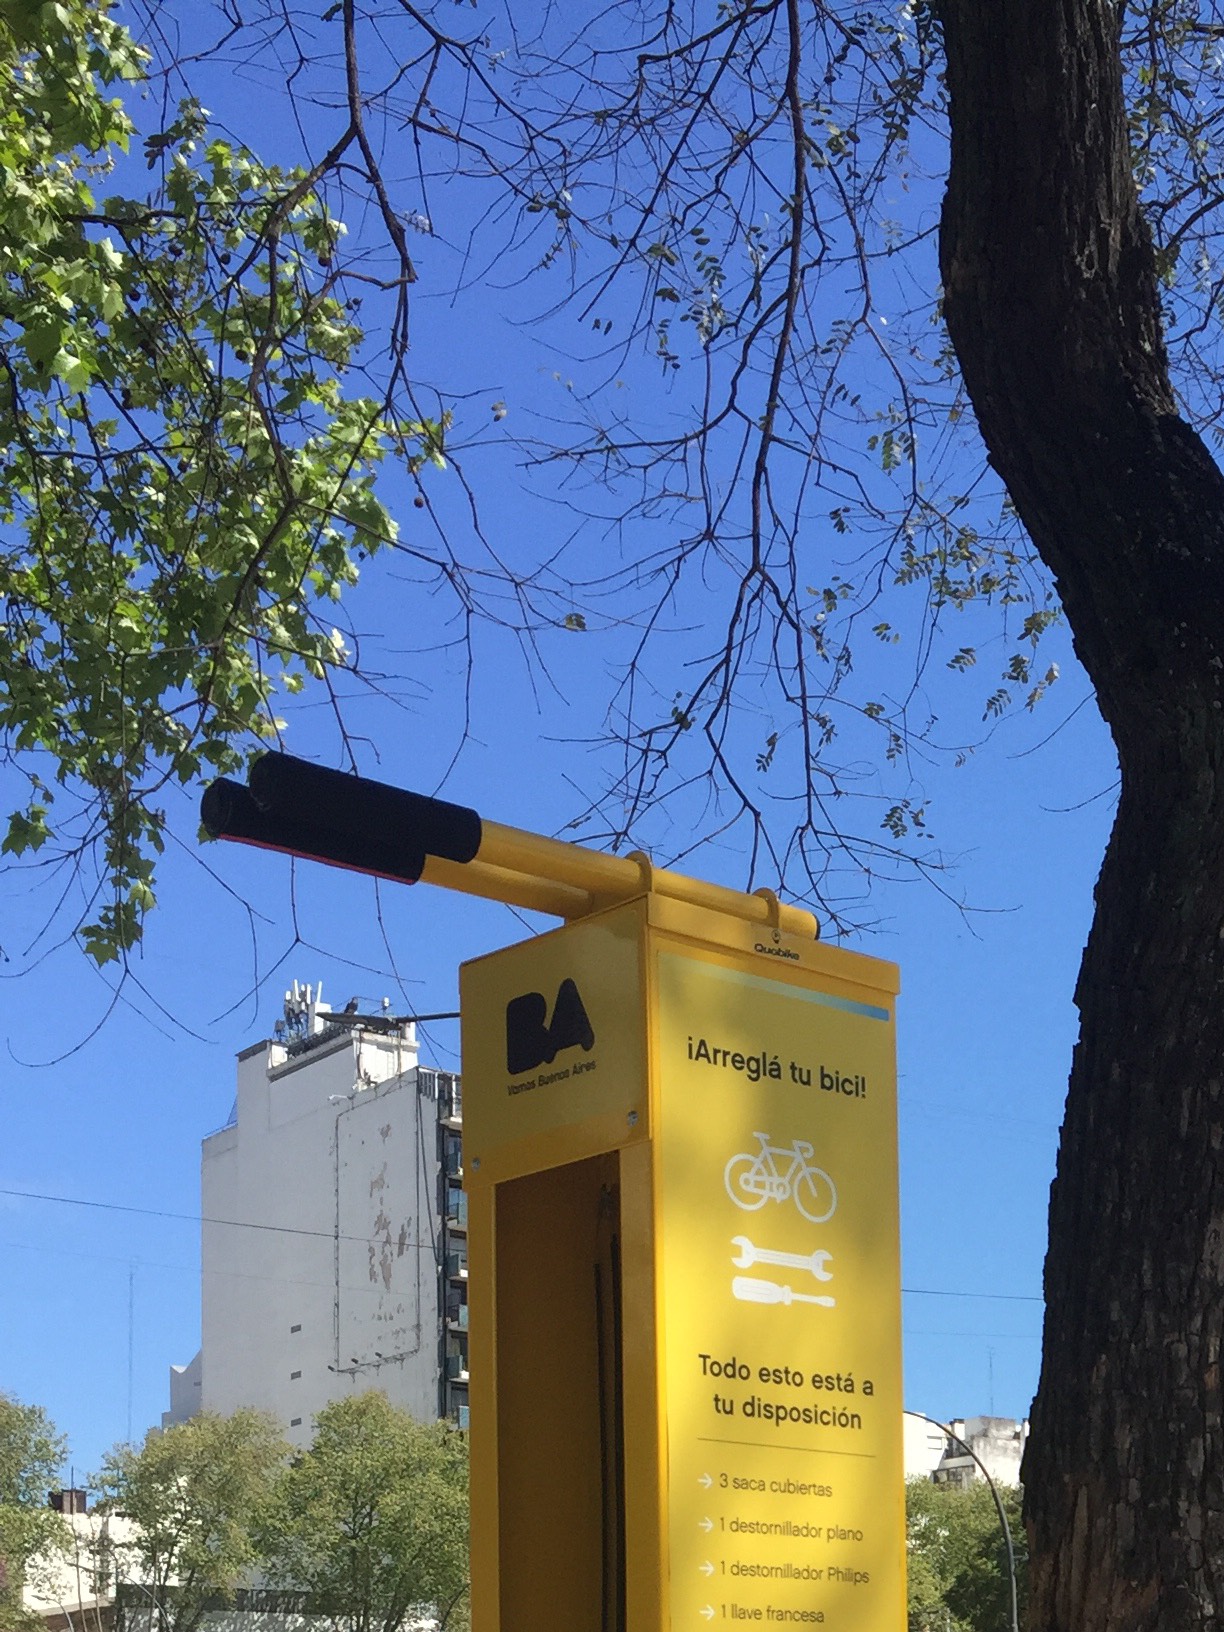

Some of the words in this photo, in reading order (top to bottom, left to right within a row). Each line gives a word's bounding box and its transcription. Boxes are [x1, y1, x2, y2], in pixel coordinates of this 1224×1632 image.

[572, 1060, 597, 1076] Aires
[688, 1036, 782, 1082] ¡Arreglá
[790, 1061, 811, 1086] tu
[820, 1065, 866, 1099] bici!
[698, 1353, 750, 1381] Todo
[758, 1366, 804, 1387] esto
[811, 1372, 855, 1394] está
[862, 1380, 874, 1396] a
[713, 1393, 734, 1415] tu
[742, 1395, 862, 1429] disposición
[719, 1473, 729, 1489] 3
[732, 1477, 766, 1492] saca
[769, 1478, 833, 1498] cubiertas
[719, 1516, 725, 1531] 1
[729, 1516, 822, 1539] destornillador
[826, 1525, 864, 1543] plano
[720, 1560, 726, 1575] 1
[730, 1560, 823, 1581] destornillador
[721, 1604, 726, 1618] 1
[731, 1603, 762, 1620] llave
[766, 1605, 825, 1623] francesa
